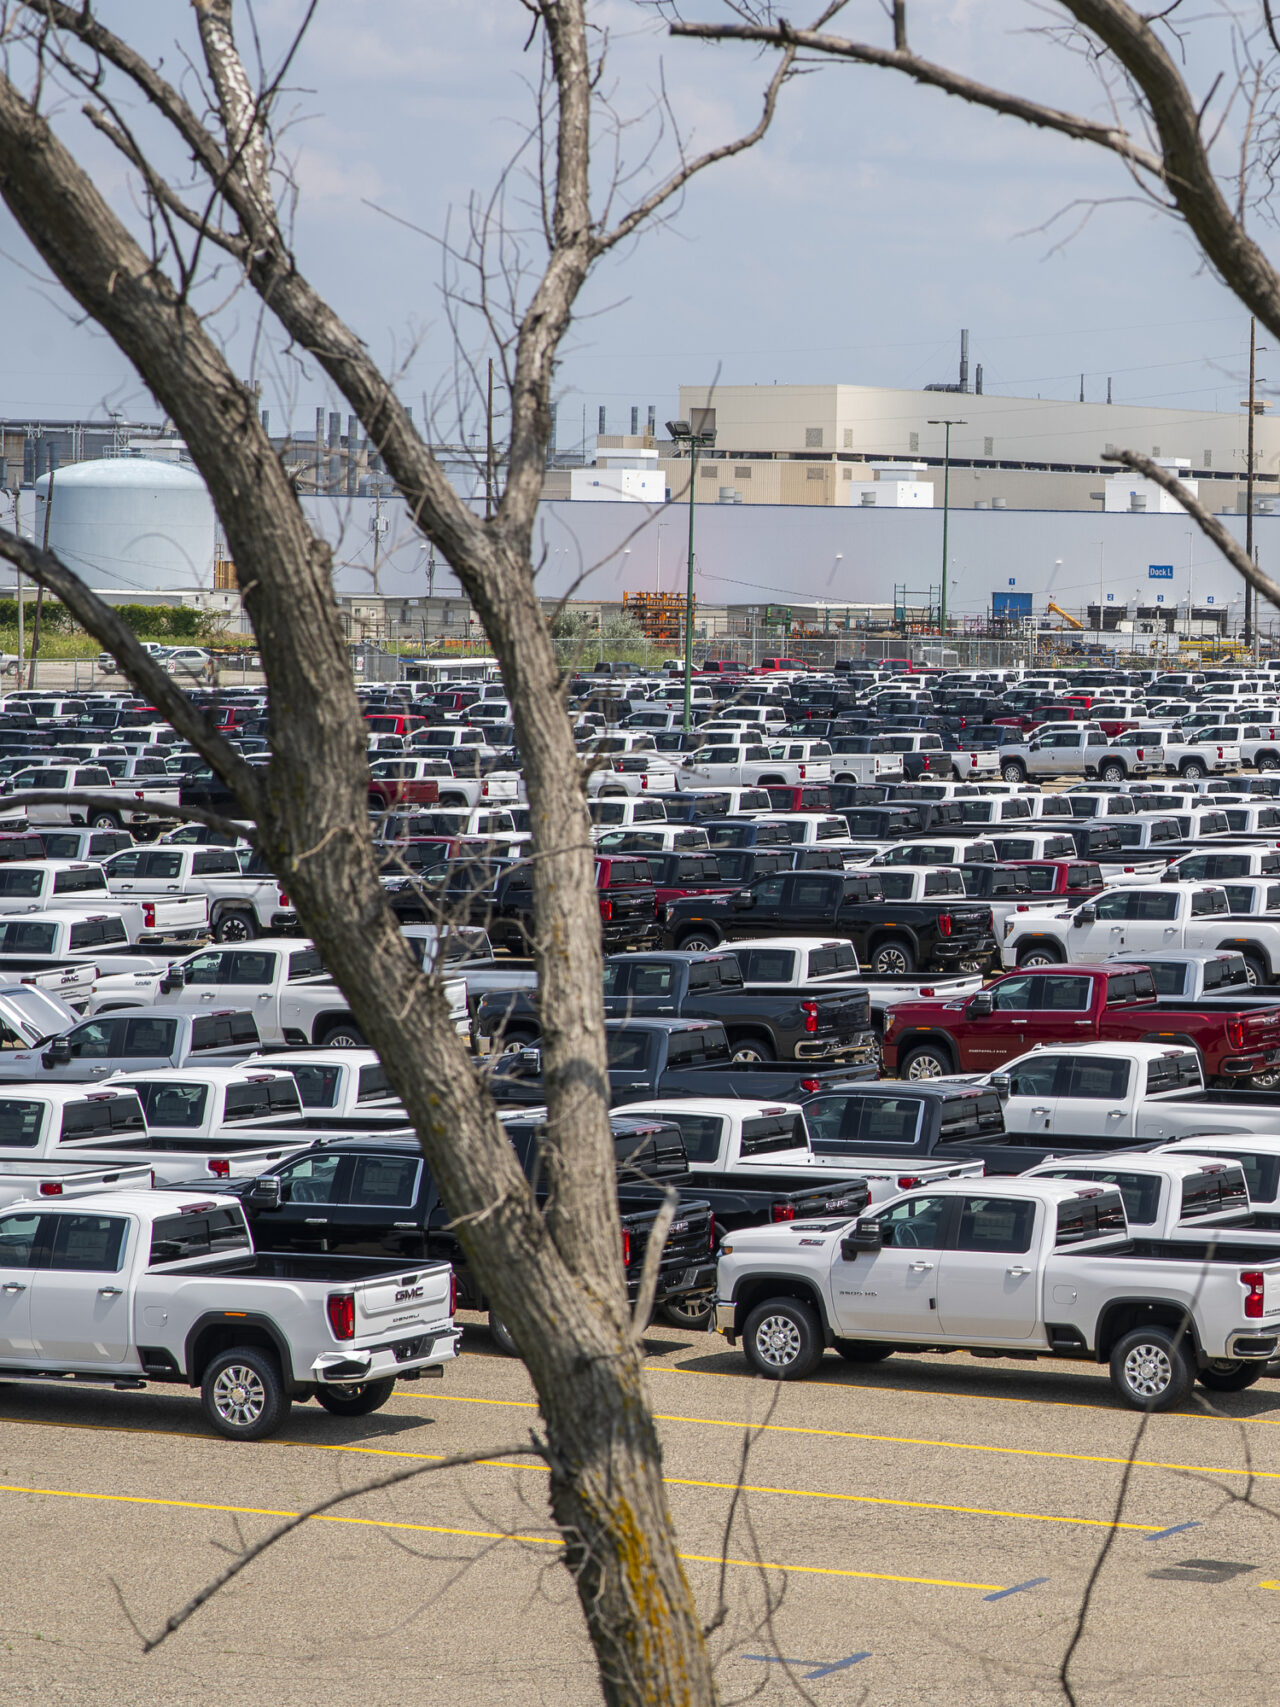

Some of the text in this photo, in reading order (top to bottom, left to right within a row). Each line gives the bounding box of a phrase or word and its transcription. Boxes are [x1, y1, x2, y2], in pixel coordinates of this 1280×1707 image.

[1150, 568, 1172, 577] Dock L
[61, 975, 80, 984] GMC
[394, 1286, 424, 1302] GMC
[392, 1313, 420, 1323] DENALI
